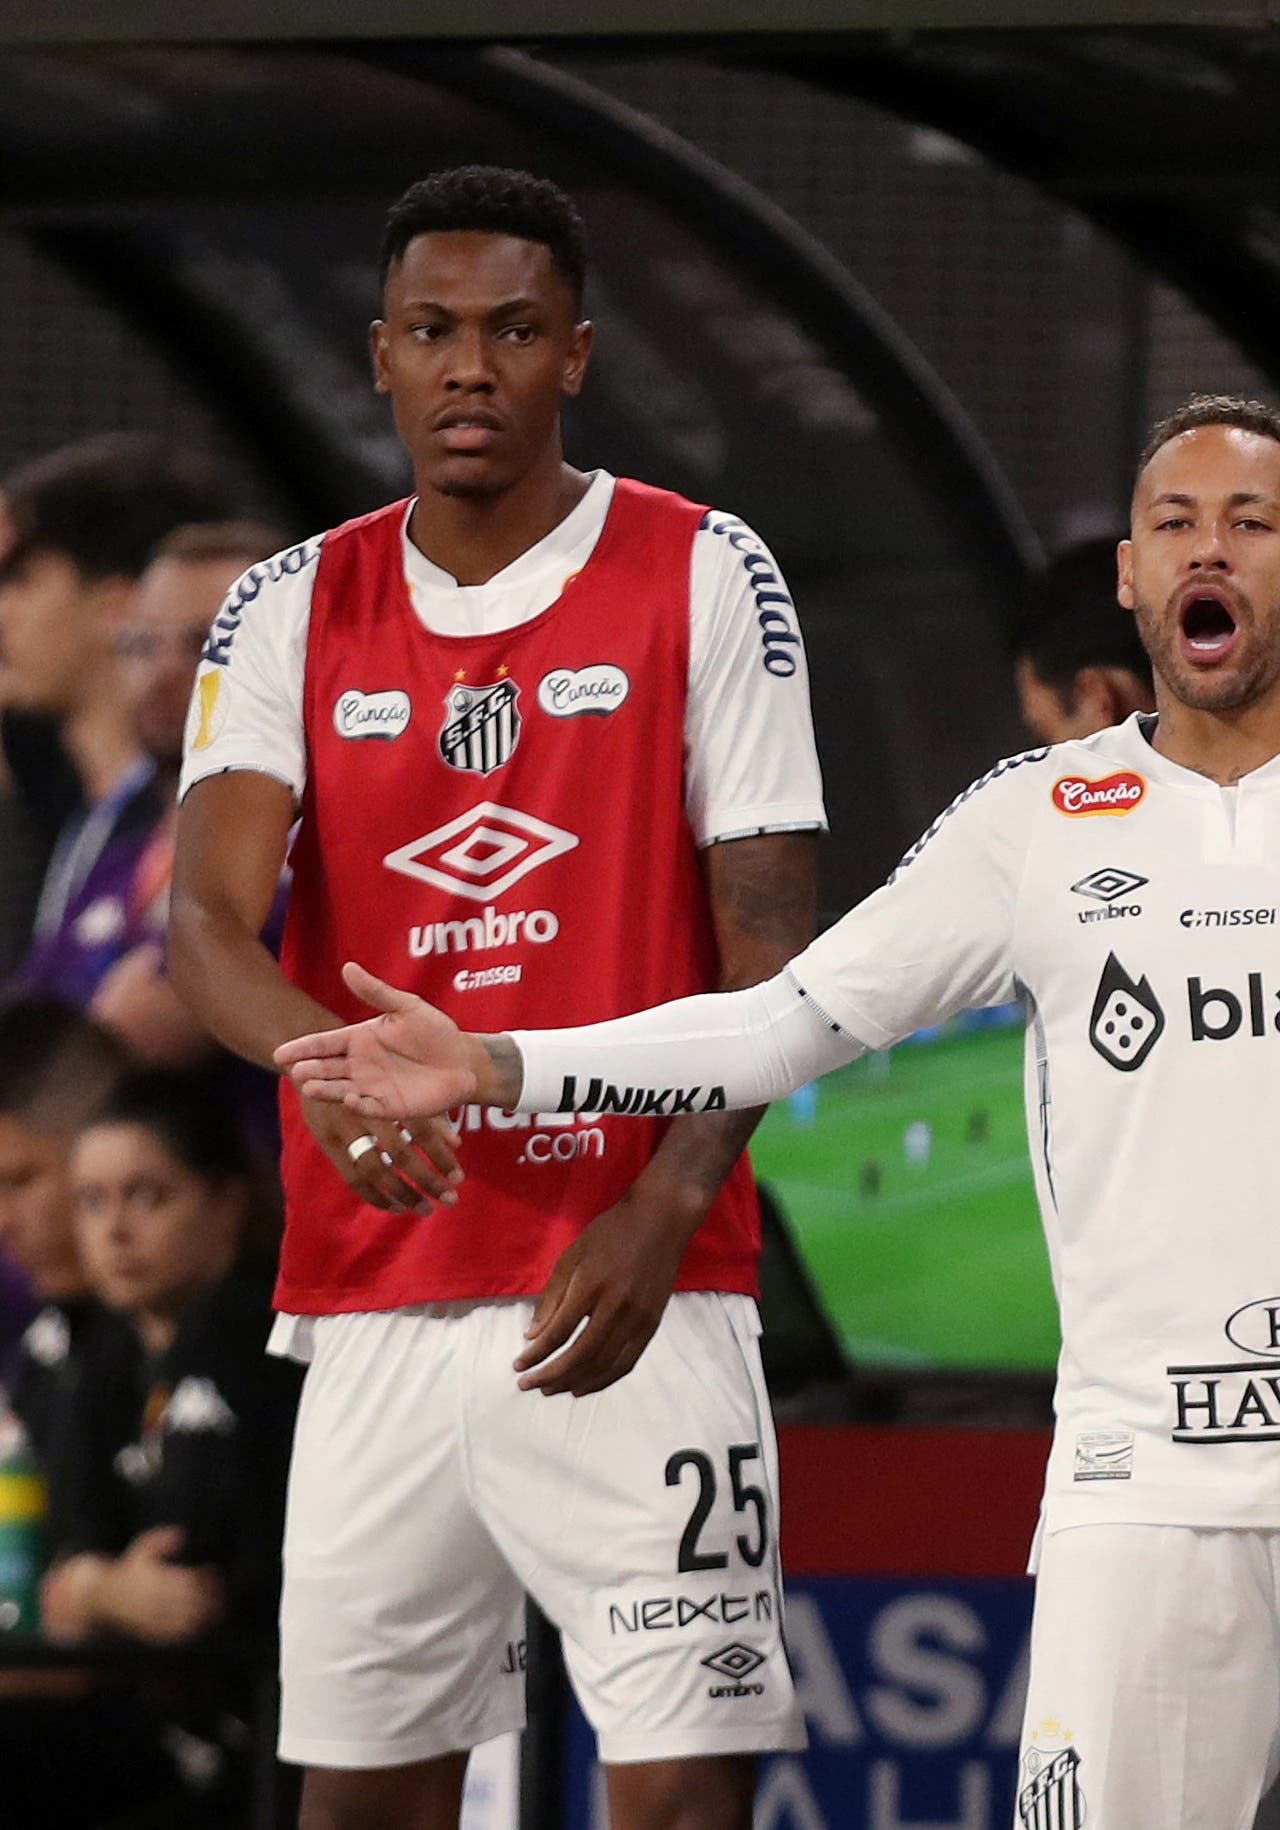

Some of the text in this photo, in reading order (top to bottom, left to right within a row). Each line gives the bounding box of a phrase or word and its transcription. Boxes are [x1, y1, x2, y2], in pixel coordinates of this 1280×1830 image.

[1058, 778, 1143, 811] Canção
[1077, 903, 1142, 924] umbro
[408, 905, 560, 958] umbro
[516, 1127, 605, 1165] .com
[664, 1442, 767, 1573] 25
[709, 1682, 765, 1698] umbro
